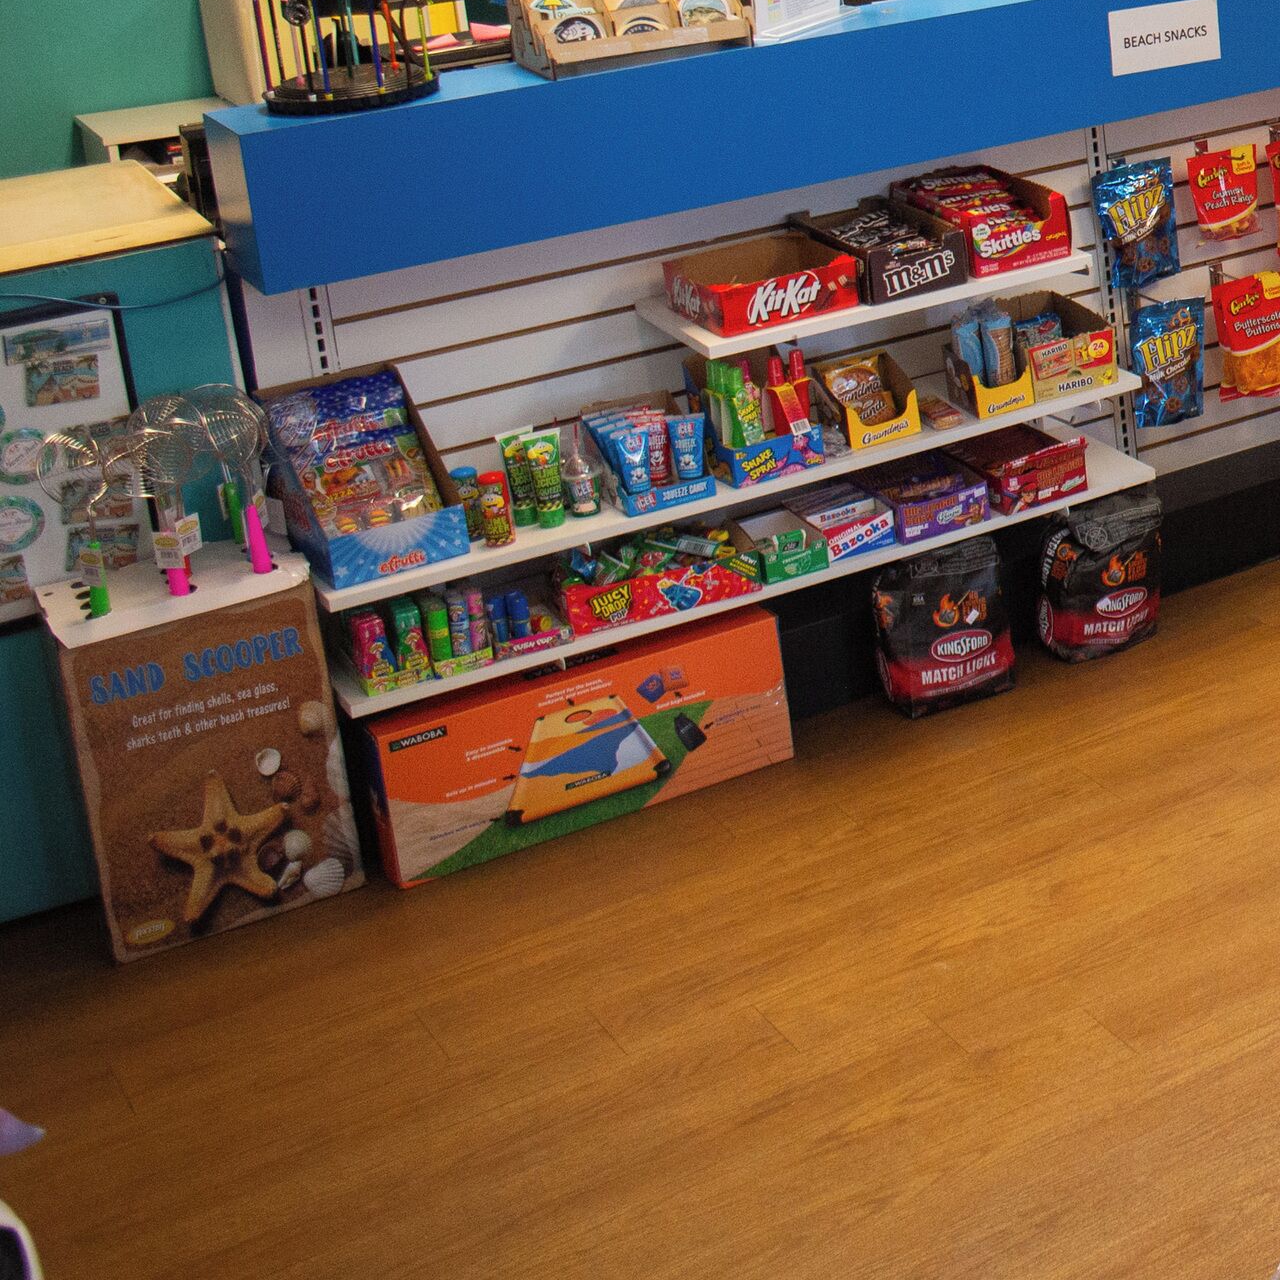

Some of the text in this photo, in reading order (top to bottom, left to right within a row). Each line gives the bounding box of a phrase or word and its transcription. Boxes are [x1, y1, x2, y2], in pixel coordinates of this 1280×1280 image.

[1123, 25, 1208, 49] BEACH SNACKS
[1109, 182, 1165, 234] Flipz
[1205, 192, 1254, 211] Peach Rings
[980, 229, 1041, 258] Skittles
[1246, 322, 1280, 337] Buttons
[1041, 343, 1068, 357] HARIBO
[1141, 326, 1195, 371] Flipz
[1058, 376, 1092, 392] HARIBO
[324, 439, 392, 470] efrutti
[741, 449, 772, 471] SNAKE
[750, 460, 777, 480] SPRAY
[637, 482, 707, 512] ICEE SQUEEZE CANDY
[833, 517, 889, 557] Bazooka
[379, 552, 426, 574] efrutti
[591, 585, 630, 612] JUICY
[602, 598, 627, 617] DROP
[1084, 622, 1124, 636] MATCH
[937, 636, 988, 656] KINGSFORD
[90, 627, 304, 705] SAND SCOOPER
[921, 651, 996, 686] MATCH LIGHT
[132, 681, 279, 728] Great for finding shells, sea glass,
[126, 697, 290, 751] sharks teeth & other beach treasures!
[400, 726, 445, 750] WABOBA
